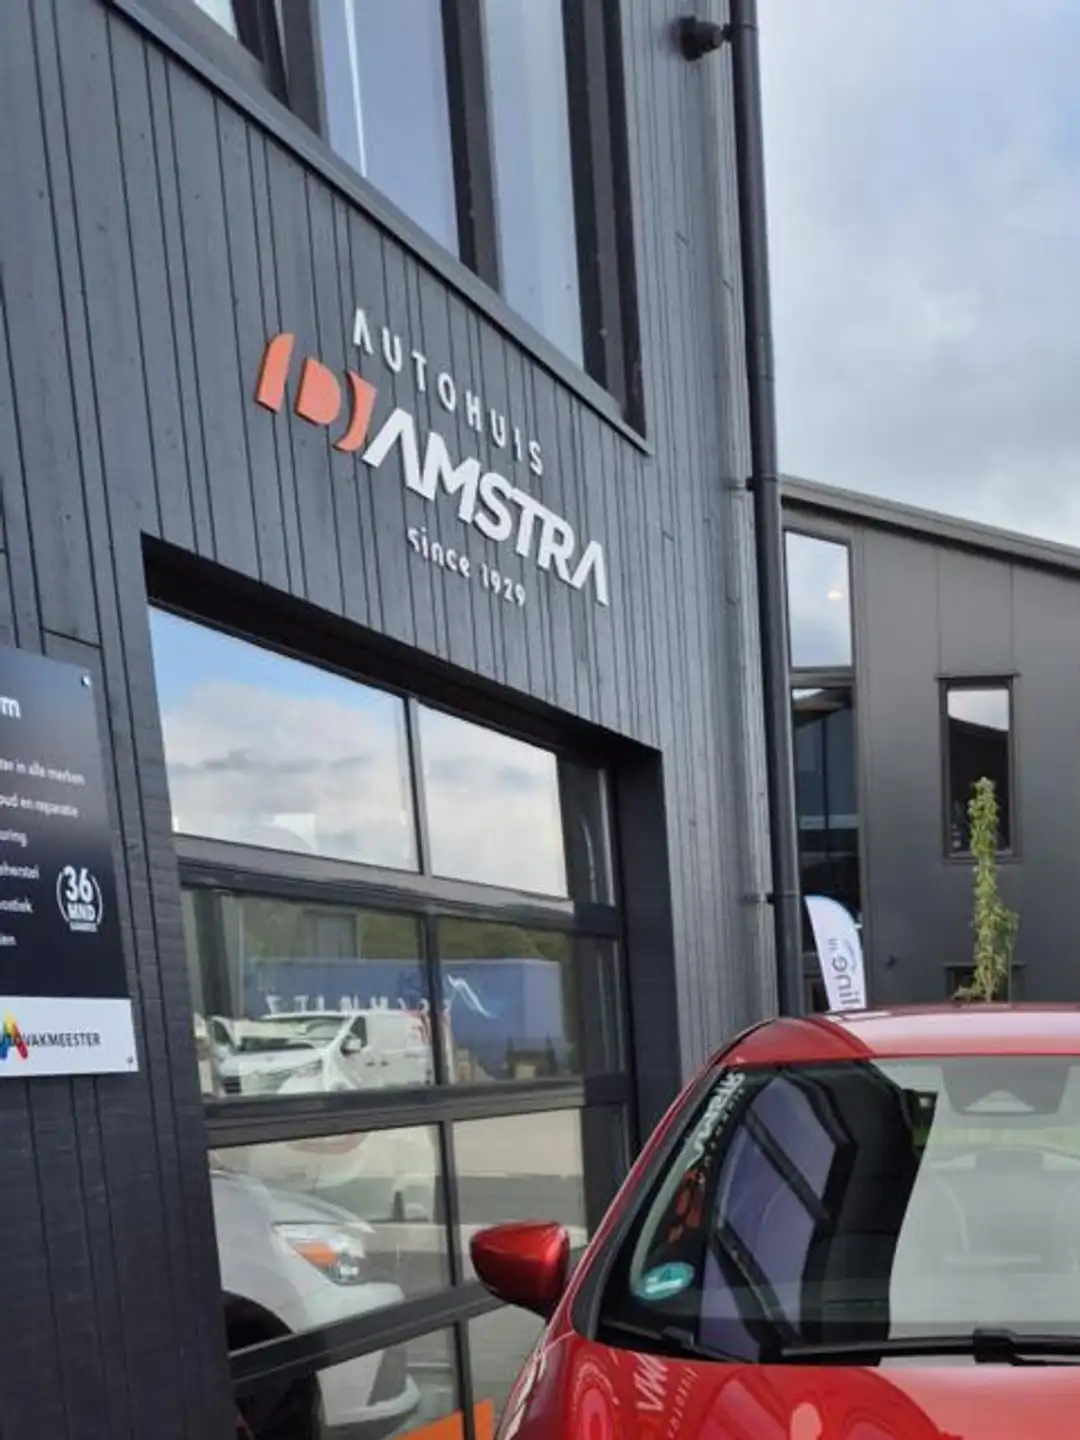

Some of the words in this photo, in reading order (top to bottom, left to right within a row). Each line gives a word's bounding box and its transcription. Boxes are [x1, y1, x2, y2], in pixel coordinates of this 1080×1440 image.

[353, 307, 545, 476] AUTOHUIS
[407, 526, 471, 579] since
[479, 562, 527, 608] 1929
[63, 865, 94, 904] 36
